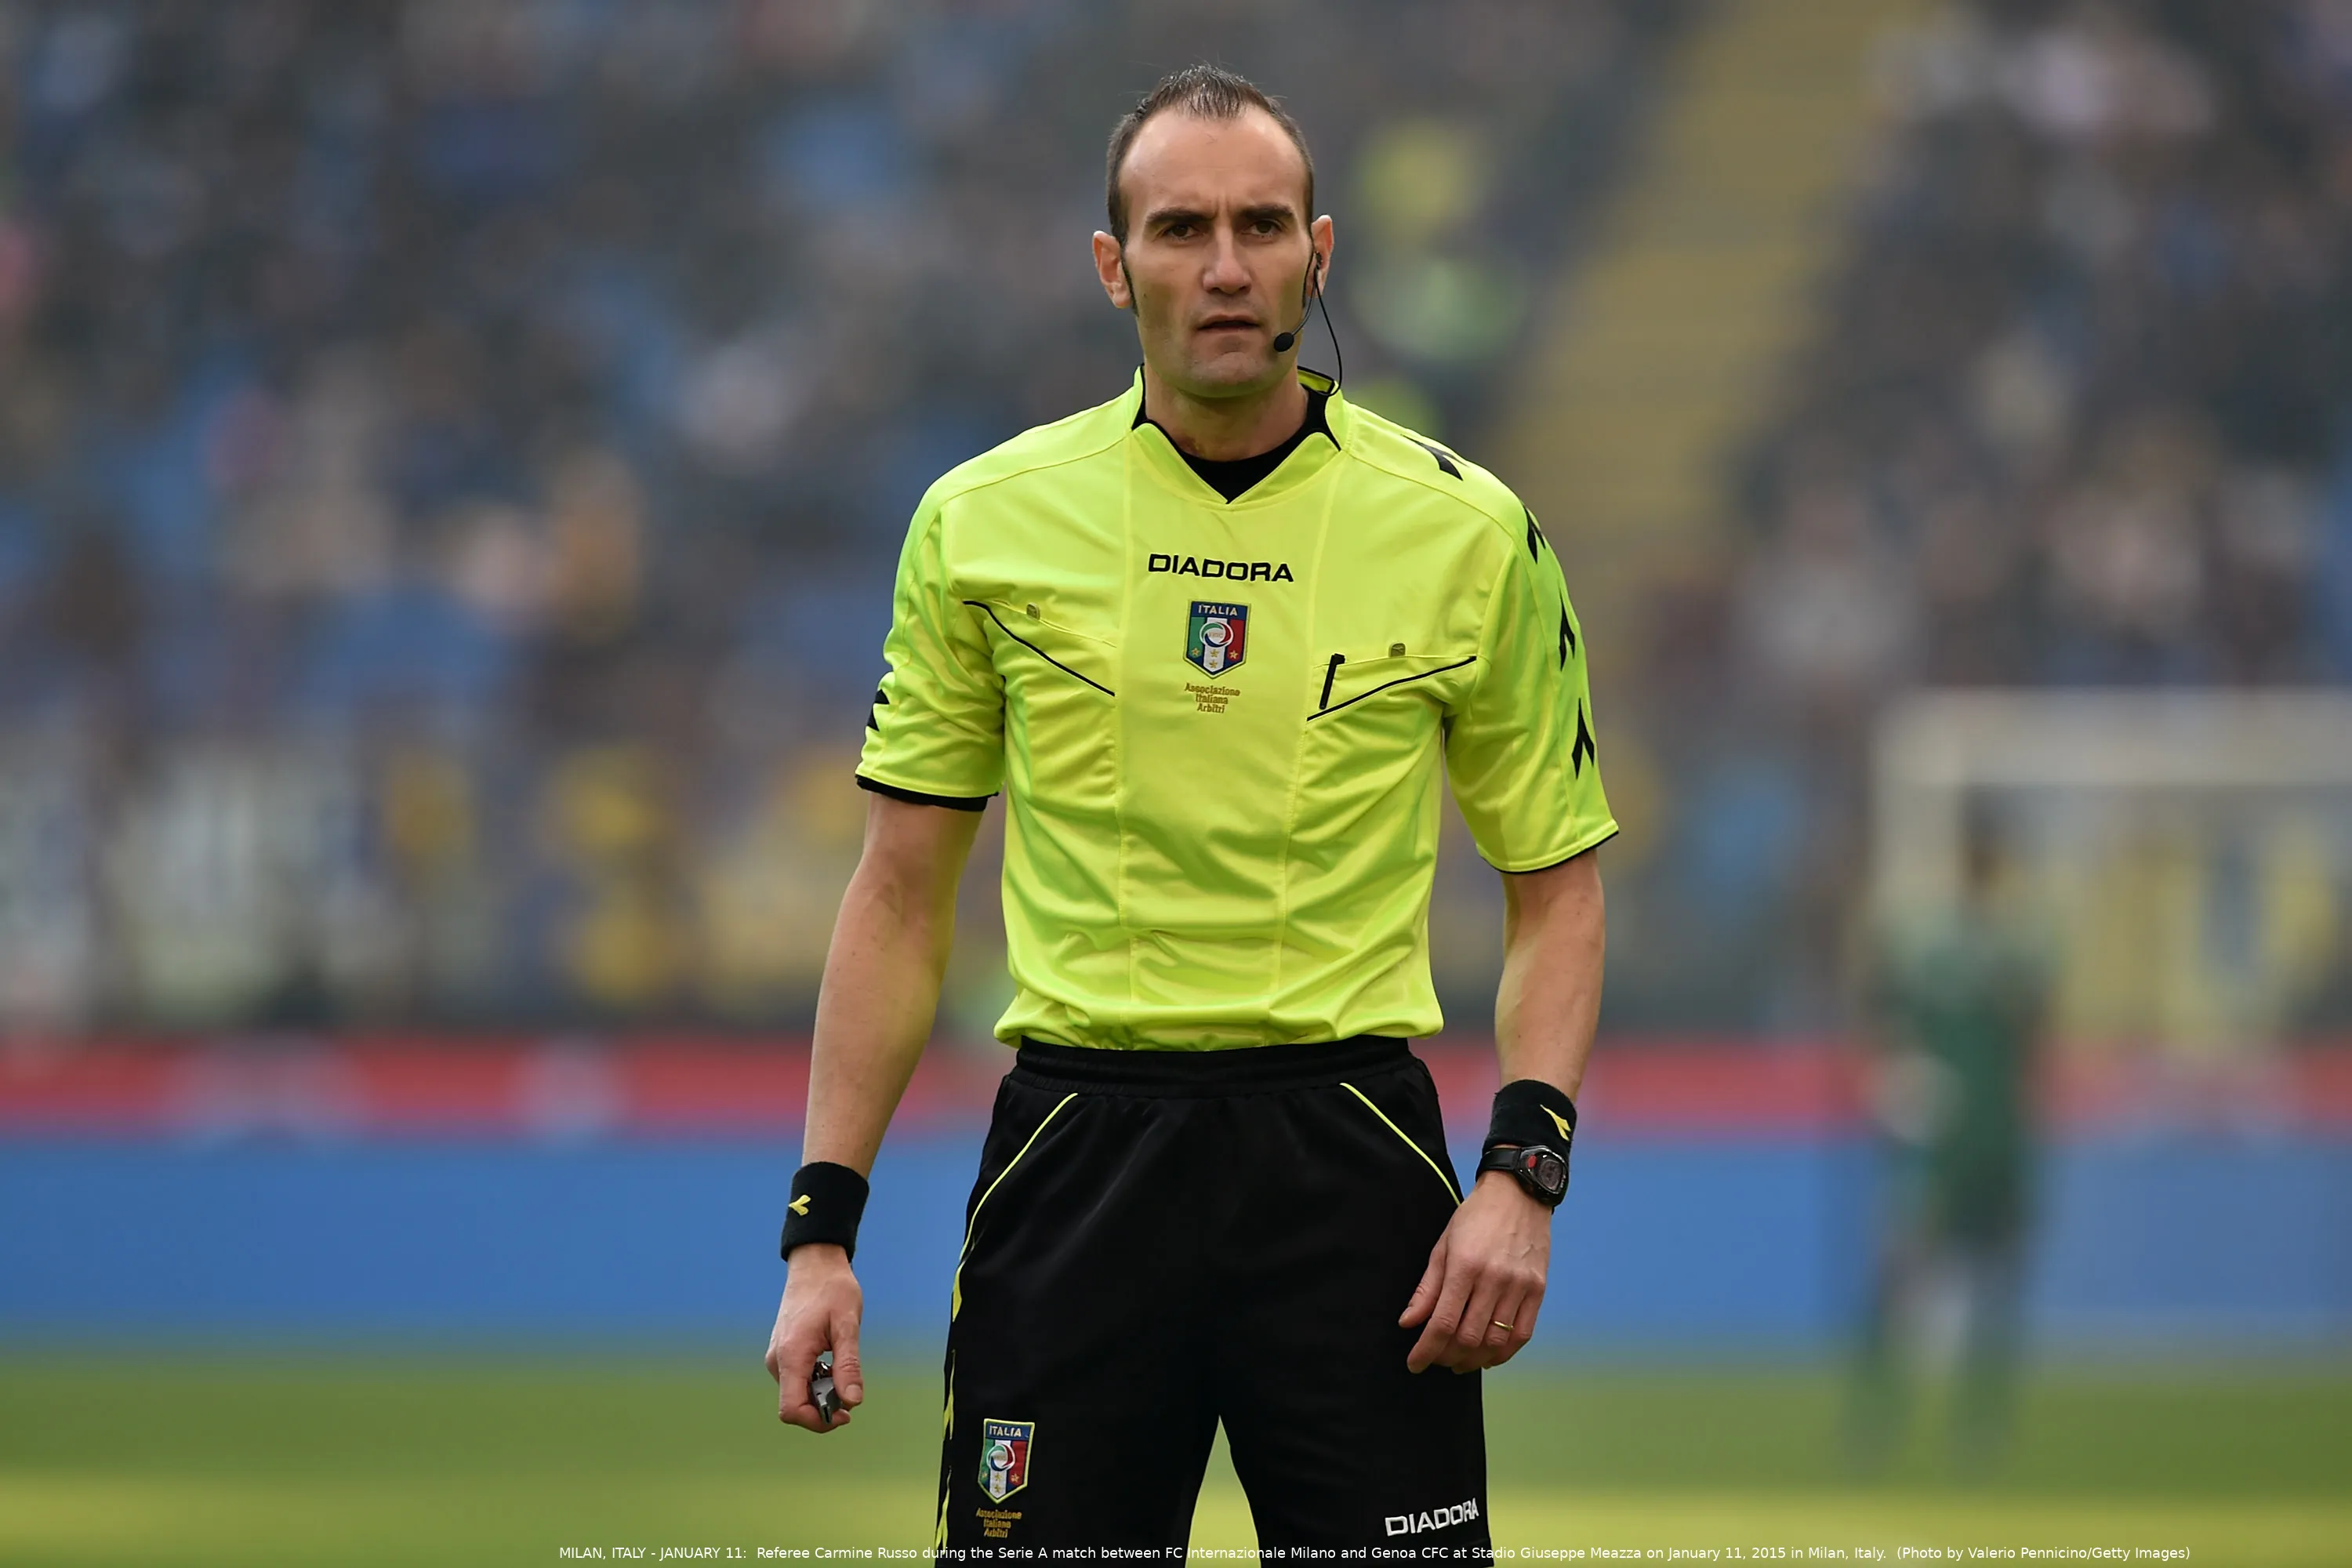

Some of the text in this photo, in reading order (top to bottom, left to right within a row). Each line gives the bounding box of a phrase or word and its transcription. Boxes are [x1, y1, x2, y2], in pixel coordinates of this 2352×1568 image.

[1148, 554, 1294, 582] DIADORA
[1198, 604, 1238, 616] ITALIA
[1185, 683, 1240, 696] Associazione
[1196, 694, 1229, 704] Italiana
[1197, 703, 1225, 713] Arbitri
[989, 1425, 1022, 1437] ITALIA
[1385, 1497, 1479, 1537] DIADORA
